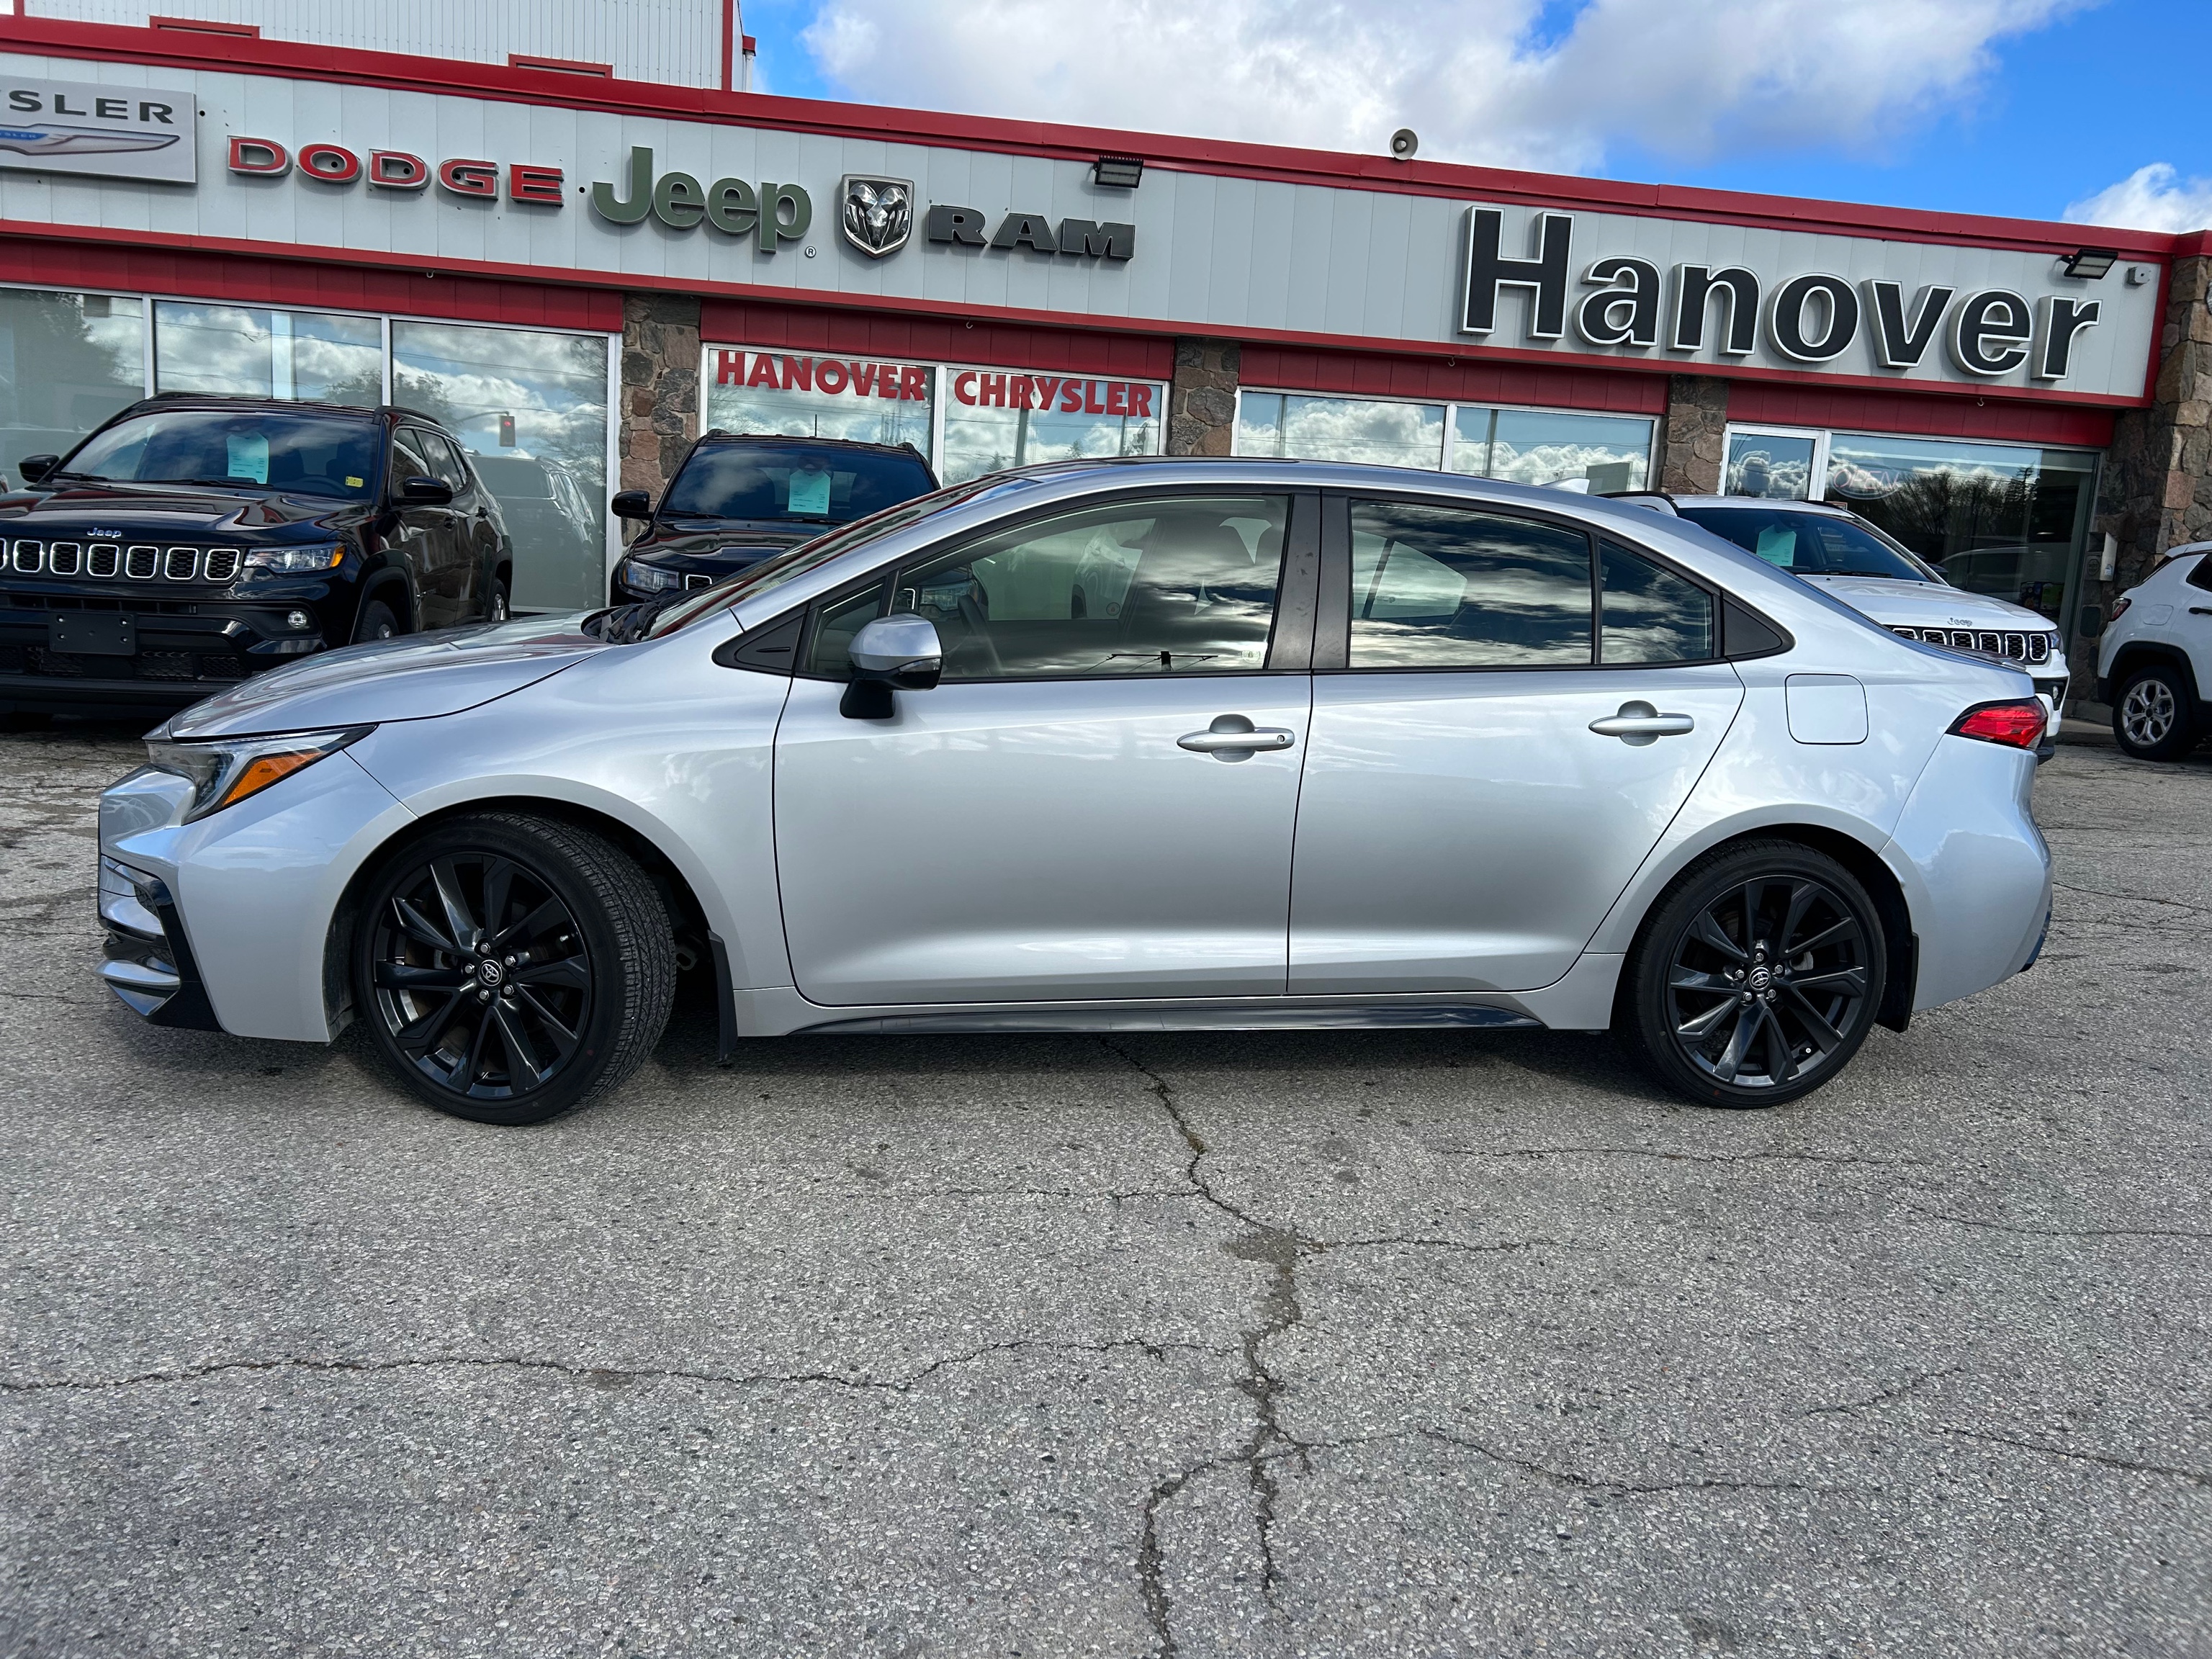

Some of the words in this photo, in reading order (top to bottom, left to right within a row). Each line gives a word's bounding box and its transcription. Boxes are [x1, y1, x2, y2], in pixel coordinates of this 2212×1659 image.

[0, 90, 174, 124] SLER
[227, 135, 564, 207] DODGE
[592, 145, 812, 253] Jeep
[929, 205, 1136, 261] RAM
[1457, 206, 2102, 380] Hanover
[717, 351, 926, 401] HANOVER
[954, 371, 1152, 418] CHRYSLER
[1833, 469, 1899, 491] OPEN
[86, 527, 122, 539] Jeep
